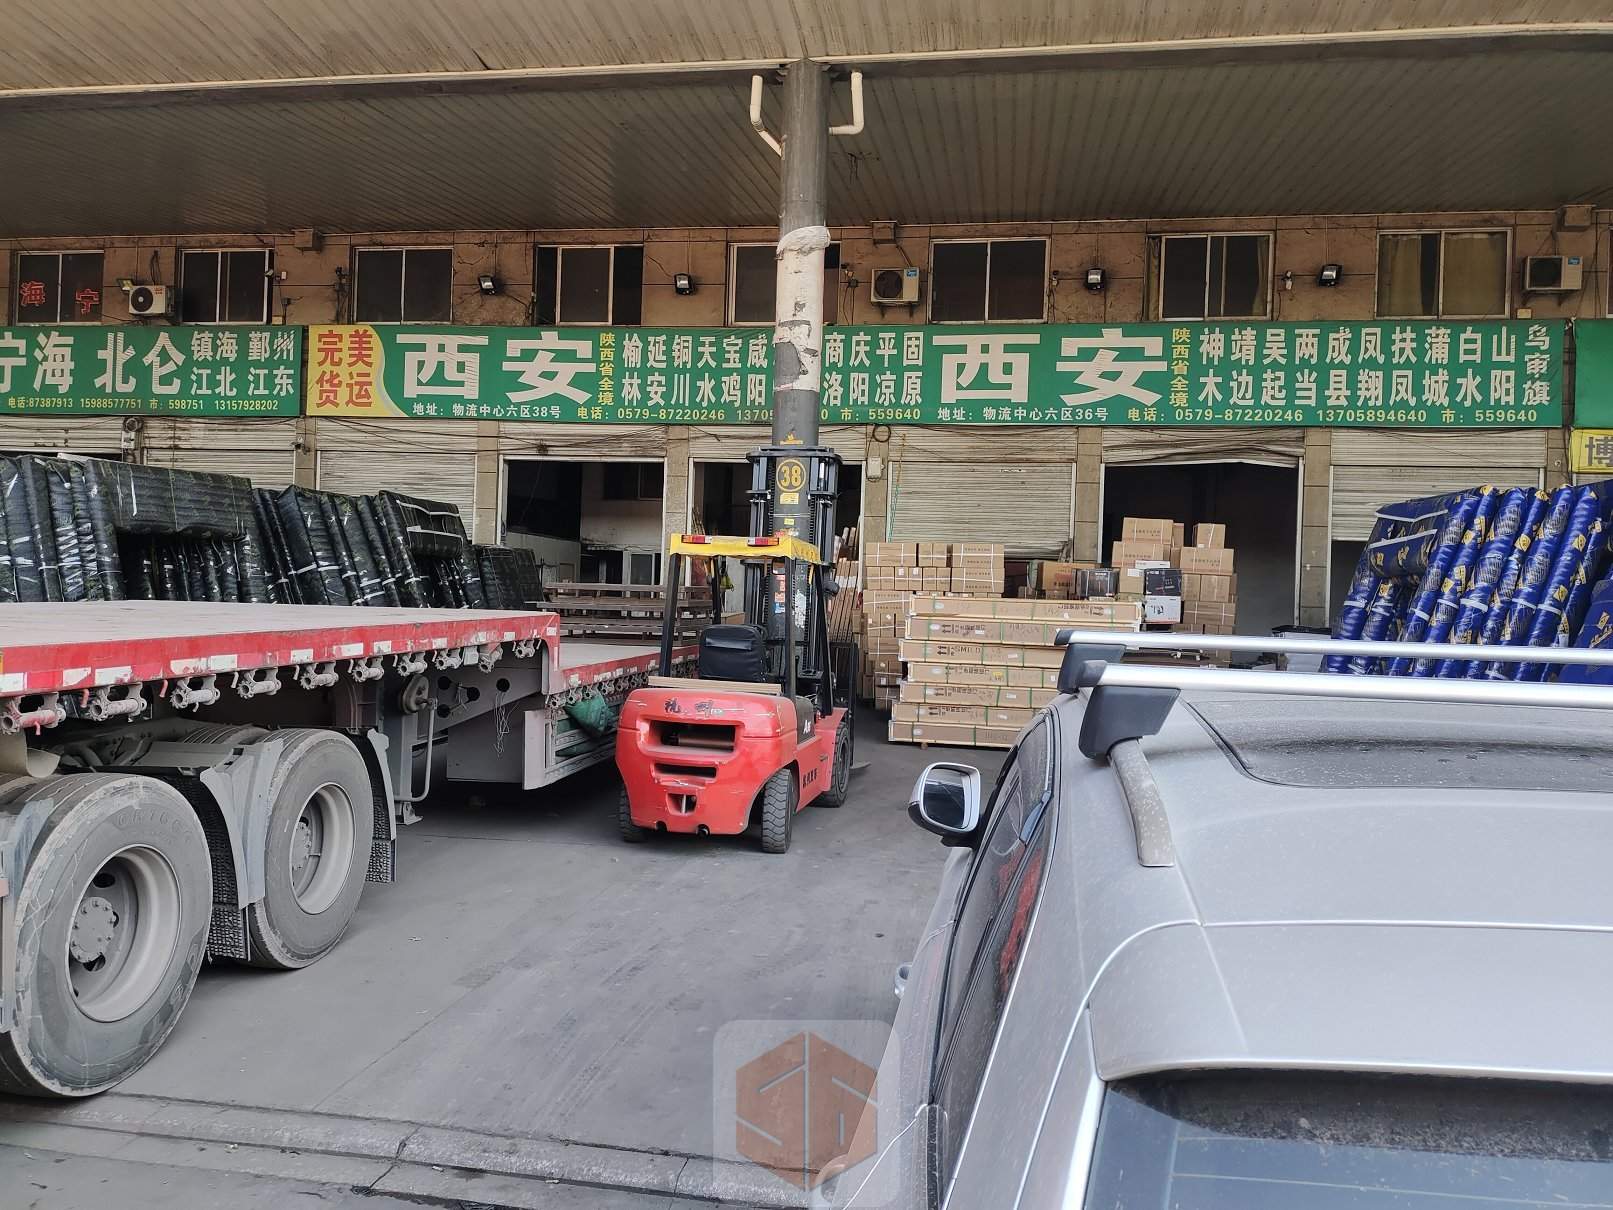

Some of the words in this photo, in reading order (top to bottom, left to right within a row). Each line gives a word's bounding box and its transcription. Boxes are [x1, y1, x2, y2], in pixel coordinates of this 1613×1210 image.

[0, 331, 75, 393] 宁海
[94, 331, 186, 395] 北仑
[190, 330, 238, 362] 镇海
[248, 330, 295, 362] 鄞州
[317, 329, 374, 368] 完美
[190, 366, 237, 397] 江北
[247, 366, 294, 397] 江东
[396, 331, 597, 404] 西安
[597, 332, 616, 406] 陕西省全境
[932, 328, 1168, 407] 西安
[1169, 328, 1191, 407] 陕西省全境
[80, 398, 142, 409] 15988577751
[214, 399, 279, 411] 13157928202
[315, 370, 373, 408] 货运
[1316, 409, 1427, 422] 13705894640
[781, 465, 802, 487] 38
